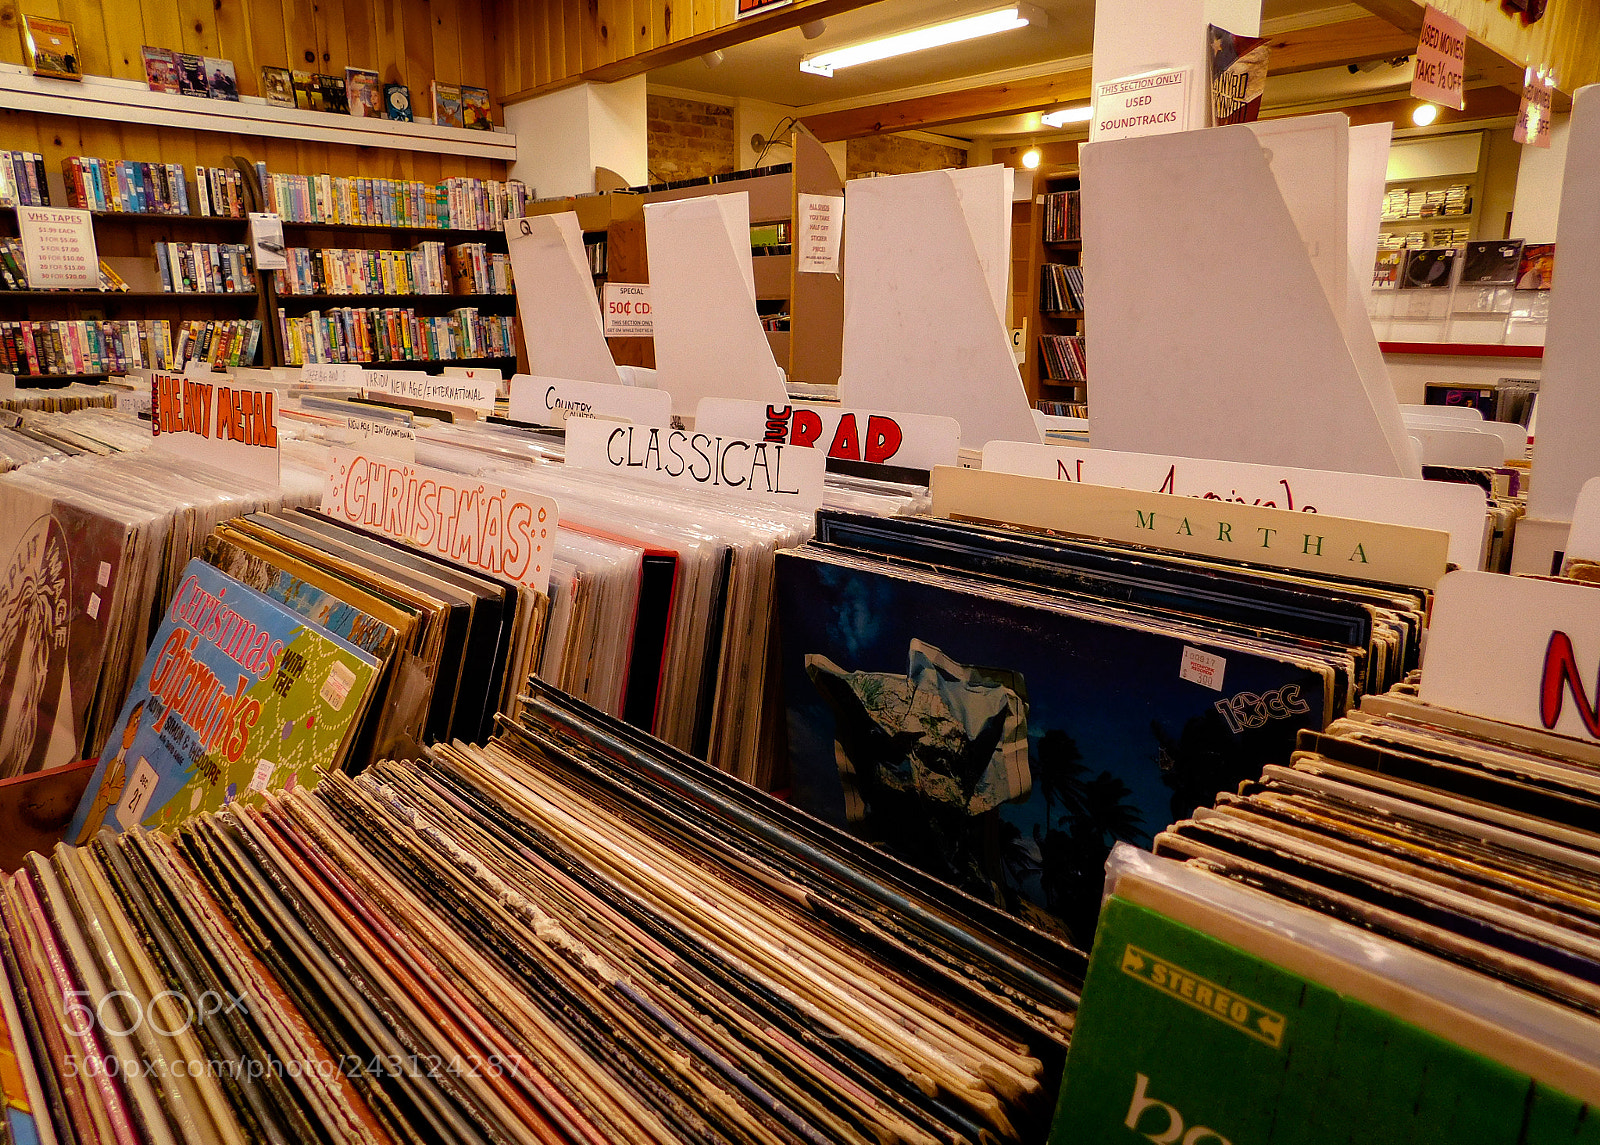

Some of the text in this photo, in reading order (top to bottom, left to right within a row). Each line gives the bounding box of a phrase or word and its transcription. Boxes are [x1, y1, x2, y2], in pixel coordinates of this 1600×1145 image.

[1421, 23, 1464, 60] USED MOVIES
[1101, 73, 1182, 95] THIS SECTION ONLY!
[1416, 59, 1435, 84] TAKE
[1448, 71, 1462, 93] OFF
[1125, 95, 1152, 108] USED
[1100, 111, 1177, 131] SOUNDTRACKS
[28, 212, 82, 223] VHS TAPES
[520, 220, 533, 236] Q
[620, 287, 644, 295] SPECIAL
[609, 300, 653, 316] 50¢ CD
[391, 379, 407, 394] NEW
[159, 375, 278, 448] HEAVY METAL
[789, 409, 904, 464] RAP
[606, 426, 799, 494] CLASSICAL
[343, 456, 533, 581] CHRISTMAS
[1135, 509, 1369, 564] MARTHA
[281, 648, 307, 679] WITH
[149, 627, 261, 763] Chipmunks
[272, 670, 297, 698] THE
[188, 741, 222, 787] THEODORE
[128, 787, 143, 814] 21
[1150, 963, 1249, 1023] STEREO
